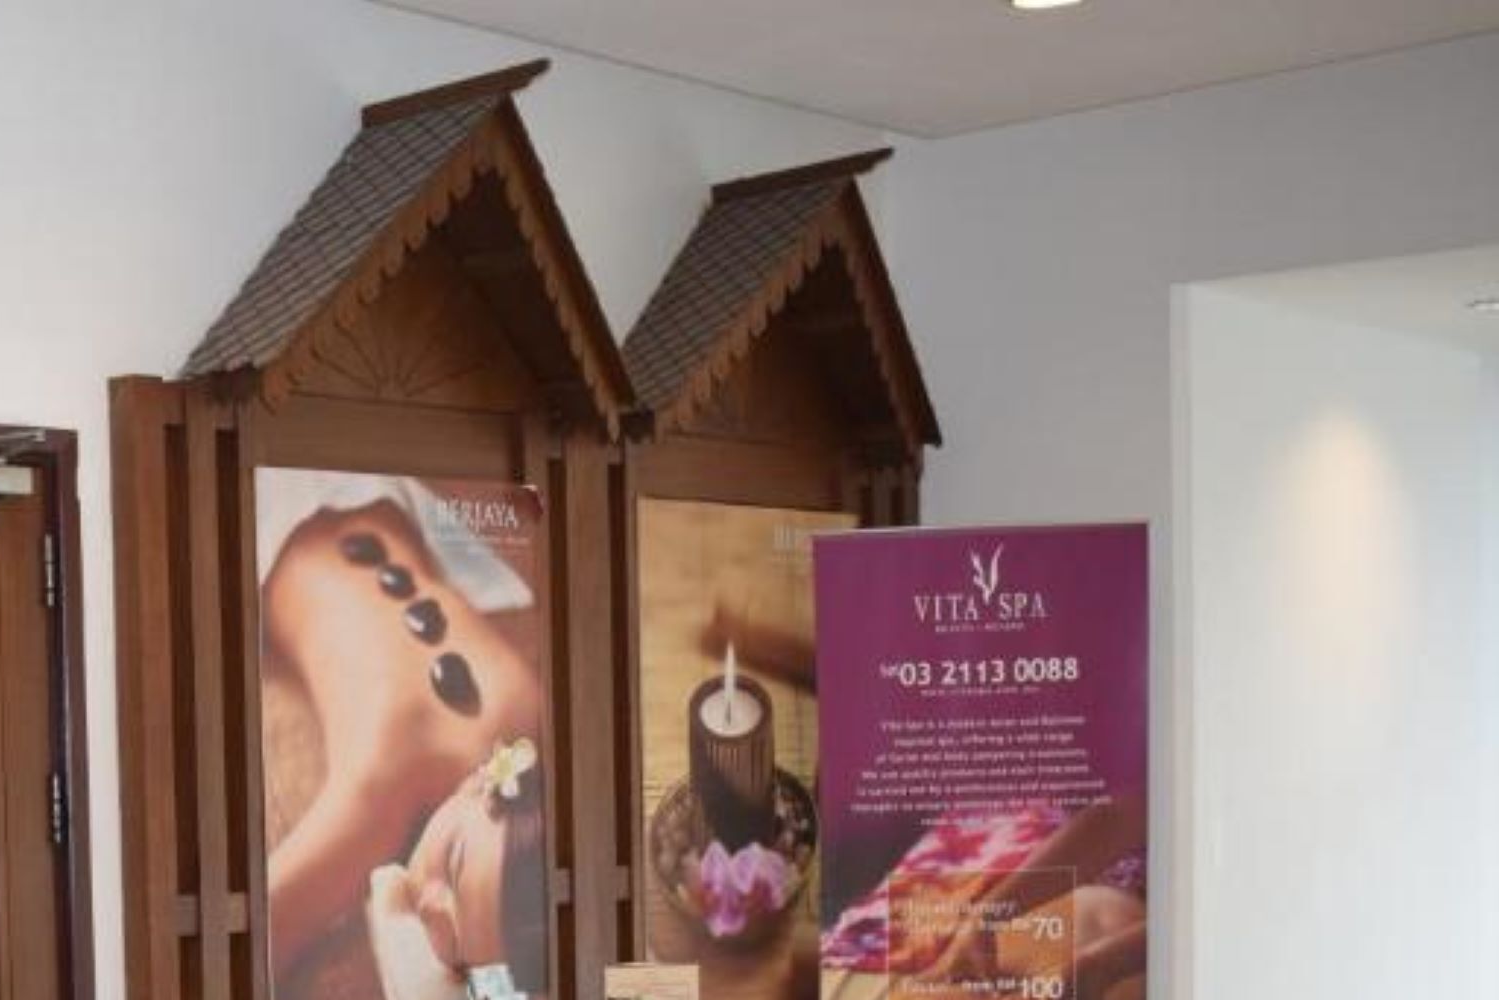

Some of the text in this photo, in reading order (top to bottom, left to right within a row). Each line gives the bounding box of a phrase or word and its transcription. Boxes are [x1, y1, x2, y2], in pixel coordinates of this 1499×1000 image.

[914, 591, 1049, 623] VITA SPA
[899, 662, 931, 687] 03
[940, 660, 1005, 686] 2113
[1014, 657, 1079, 683] 0088
